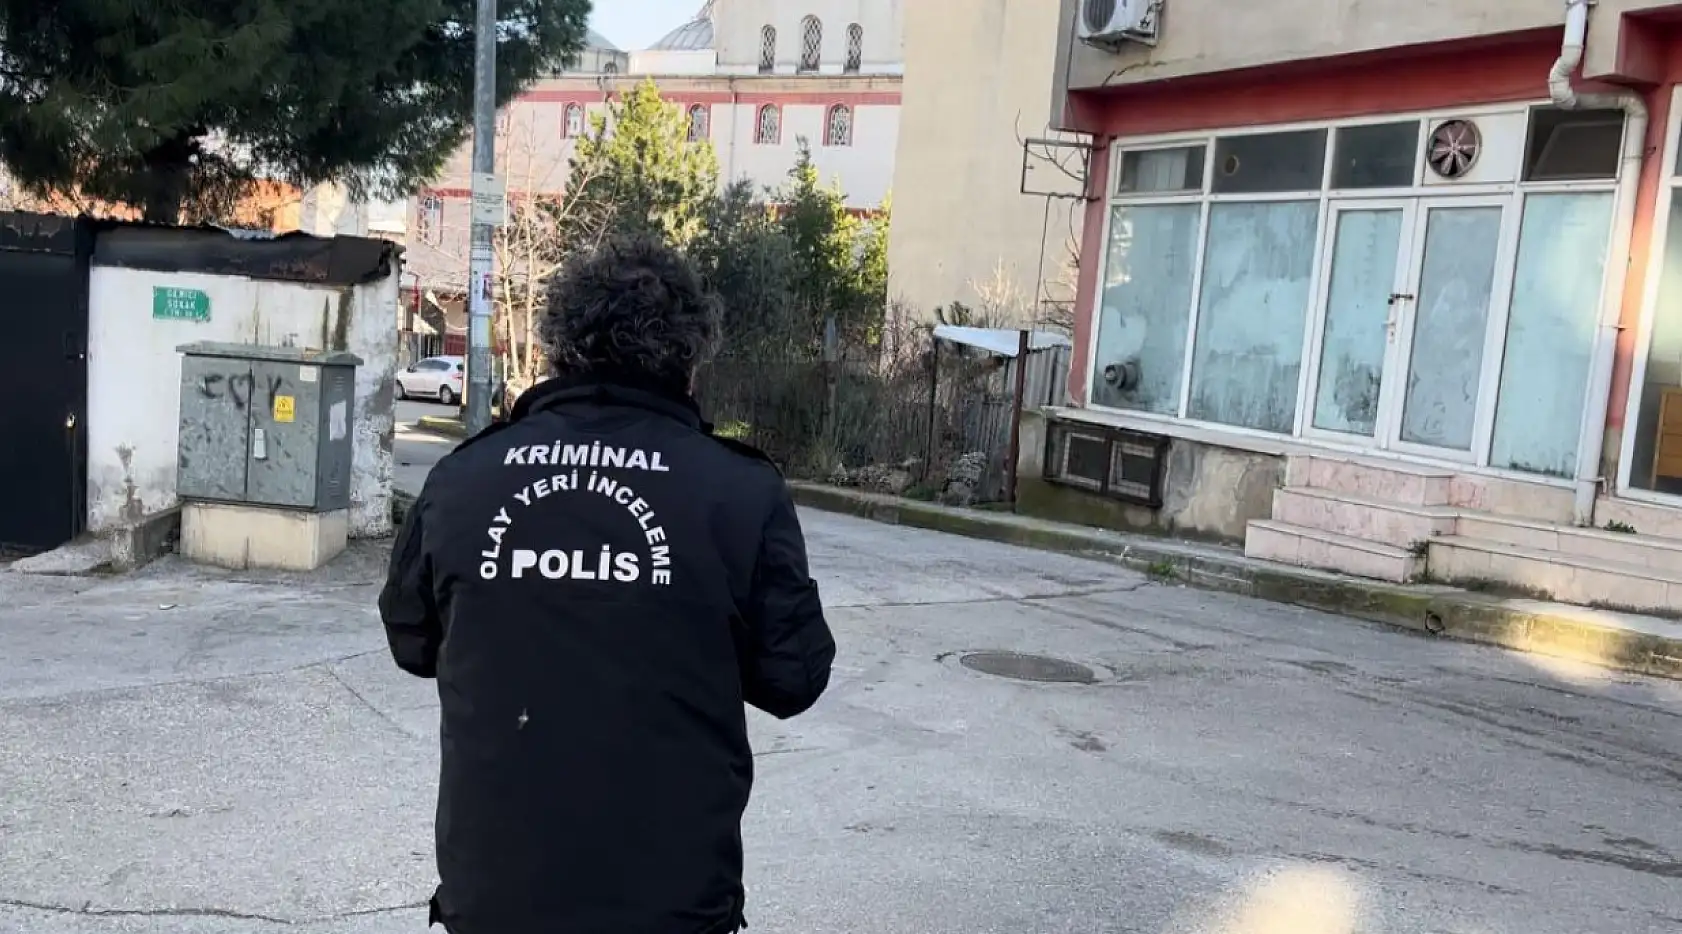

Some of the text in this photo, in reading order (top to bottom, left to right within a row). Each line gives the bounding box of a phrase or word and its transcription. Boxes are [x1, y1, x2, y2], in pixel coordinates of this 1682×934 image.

[503, 440, 671, 472] KRİMİNAL
[480, 469, 672, 585] OLAY YERİ İNCELEME
[511, 544, 640, 583] POLİS
